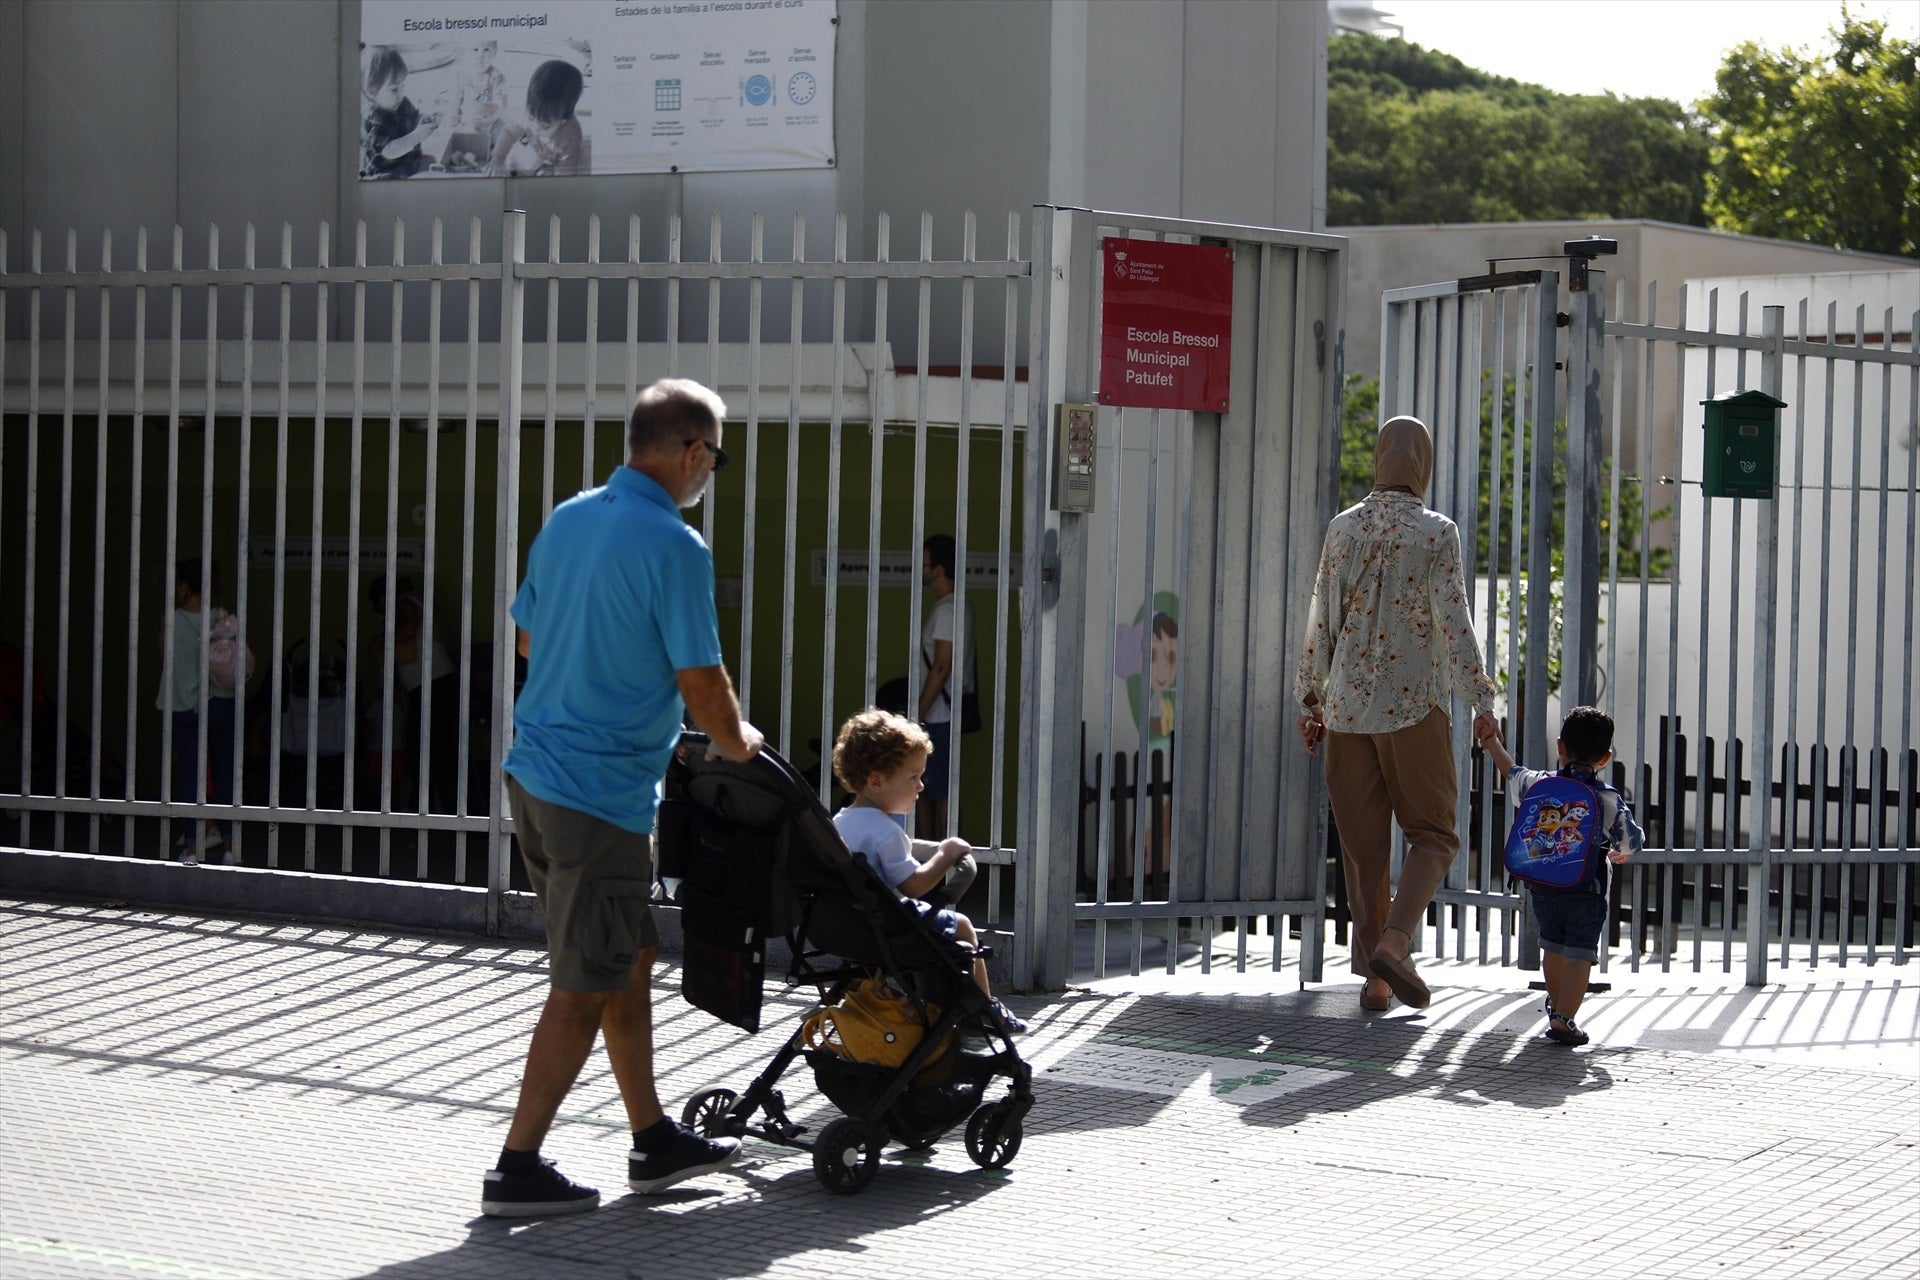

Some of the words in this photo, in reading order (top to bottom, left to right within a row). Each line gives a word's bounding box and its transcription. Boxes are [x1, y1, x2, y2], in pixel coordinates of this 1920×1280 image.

[615, 7, 649, 17] Estades
[650, 5, 662, 15] de
[664, 5, 672, 14] la
[744, 0, 773, 10] durant
[774, 0, 783, 8] el
[784, 0, 804, 8] curs
[404, 18, 442, 31] Escola
[445, 16, 488, 30] bressol
[491, 13, 548, 29] municipal
[1130, 261, 1157, 269] Ajuntament
[1136, 274, 1160, 283] Llobregat
[1127, 327, 1169, 344] Escola
[1172, 330, 1219, 348] Bressol
[1126, 348, 1190, 368] Municipal
[1126, 369, 1174, 387] Patufet
